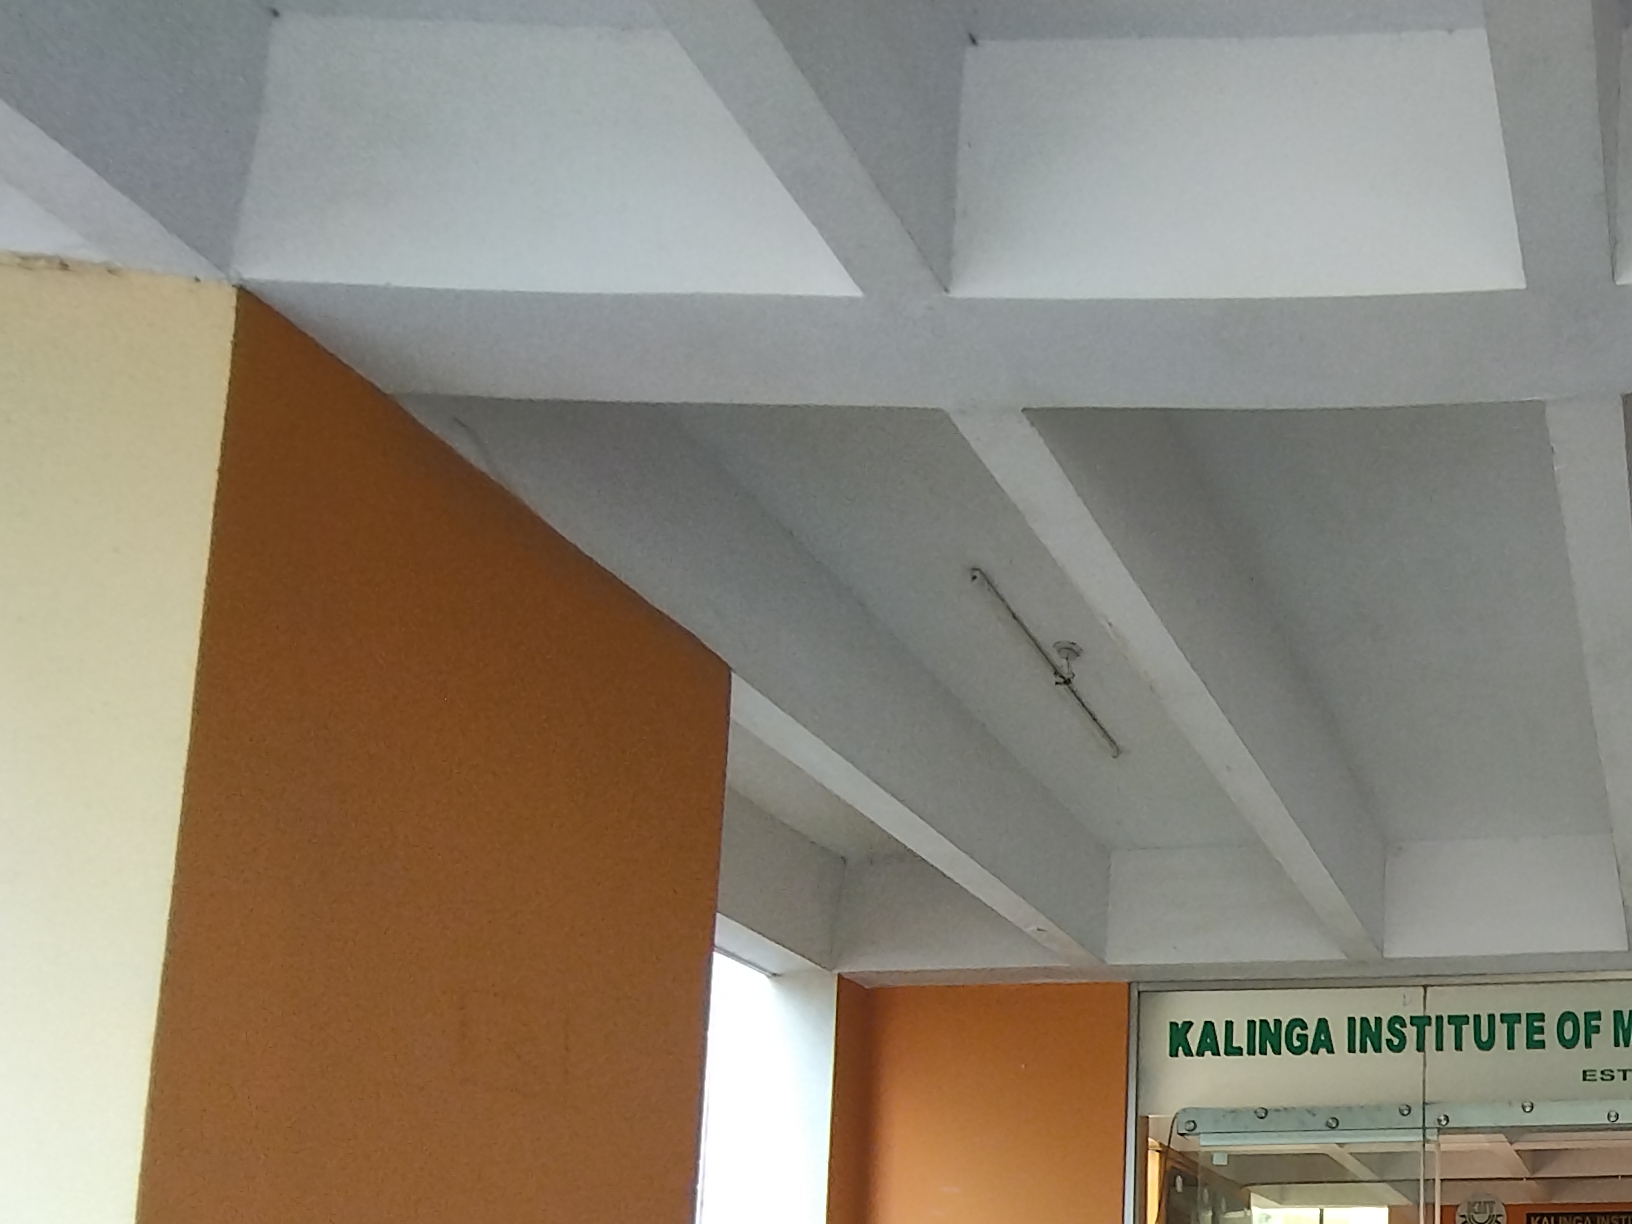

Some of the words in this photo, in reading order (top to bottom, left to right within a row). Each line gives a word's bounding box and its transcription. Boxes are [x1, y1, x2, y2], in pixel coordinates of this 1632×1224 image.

[1169, 1018, 1334, 1057] KALINGA
[1347, 1012, 1546, 1054] INSTITUTE
[1556, 1011, 1602, 1050] OF
